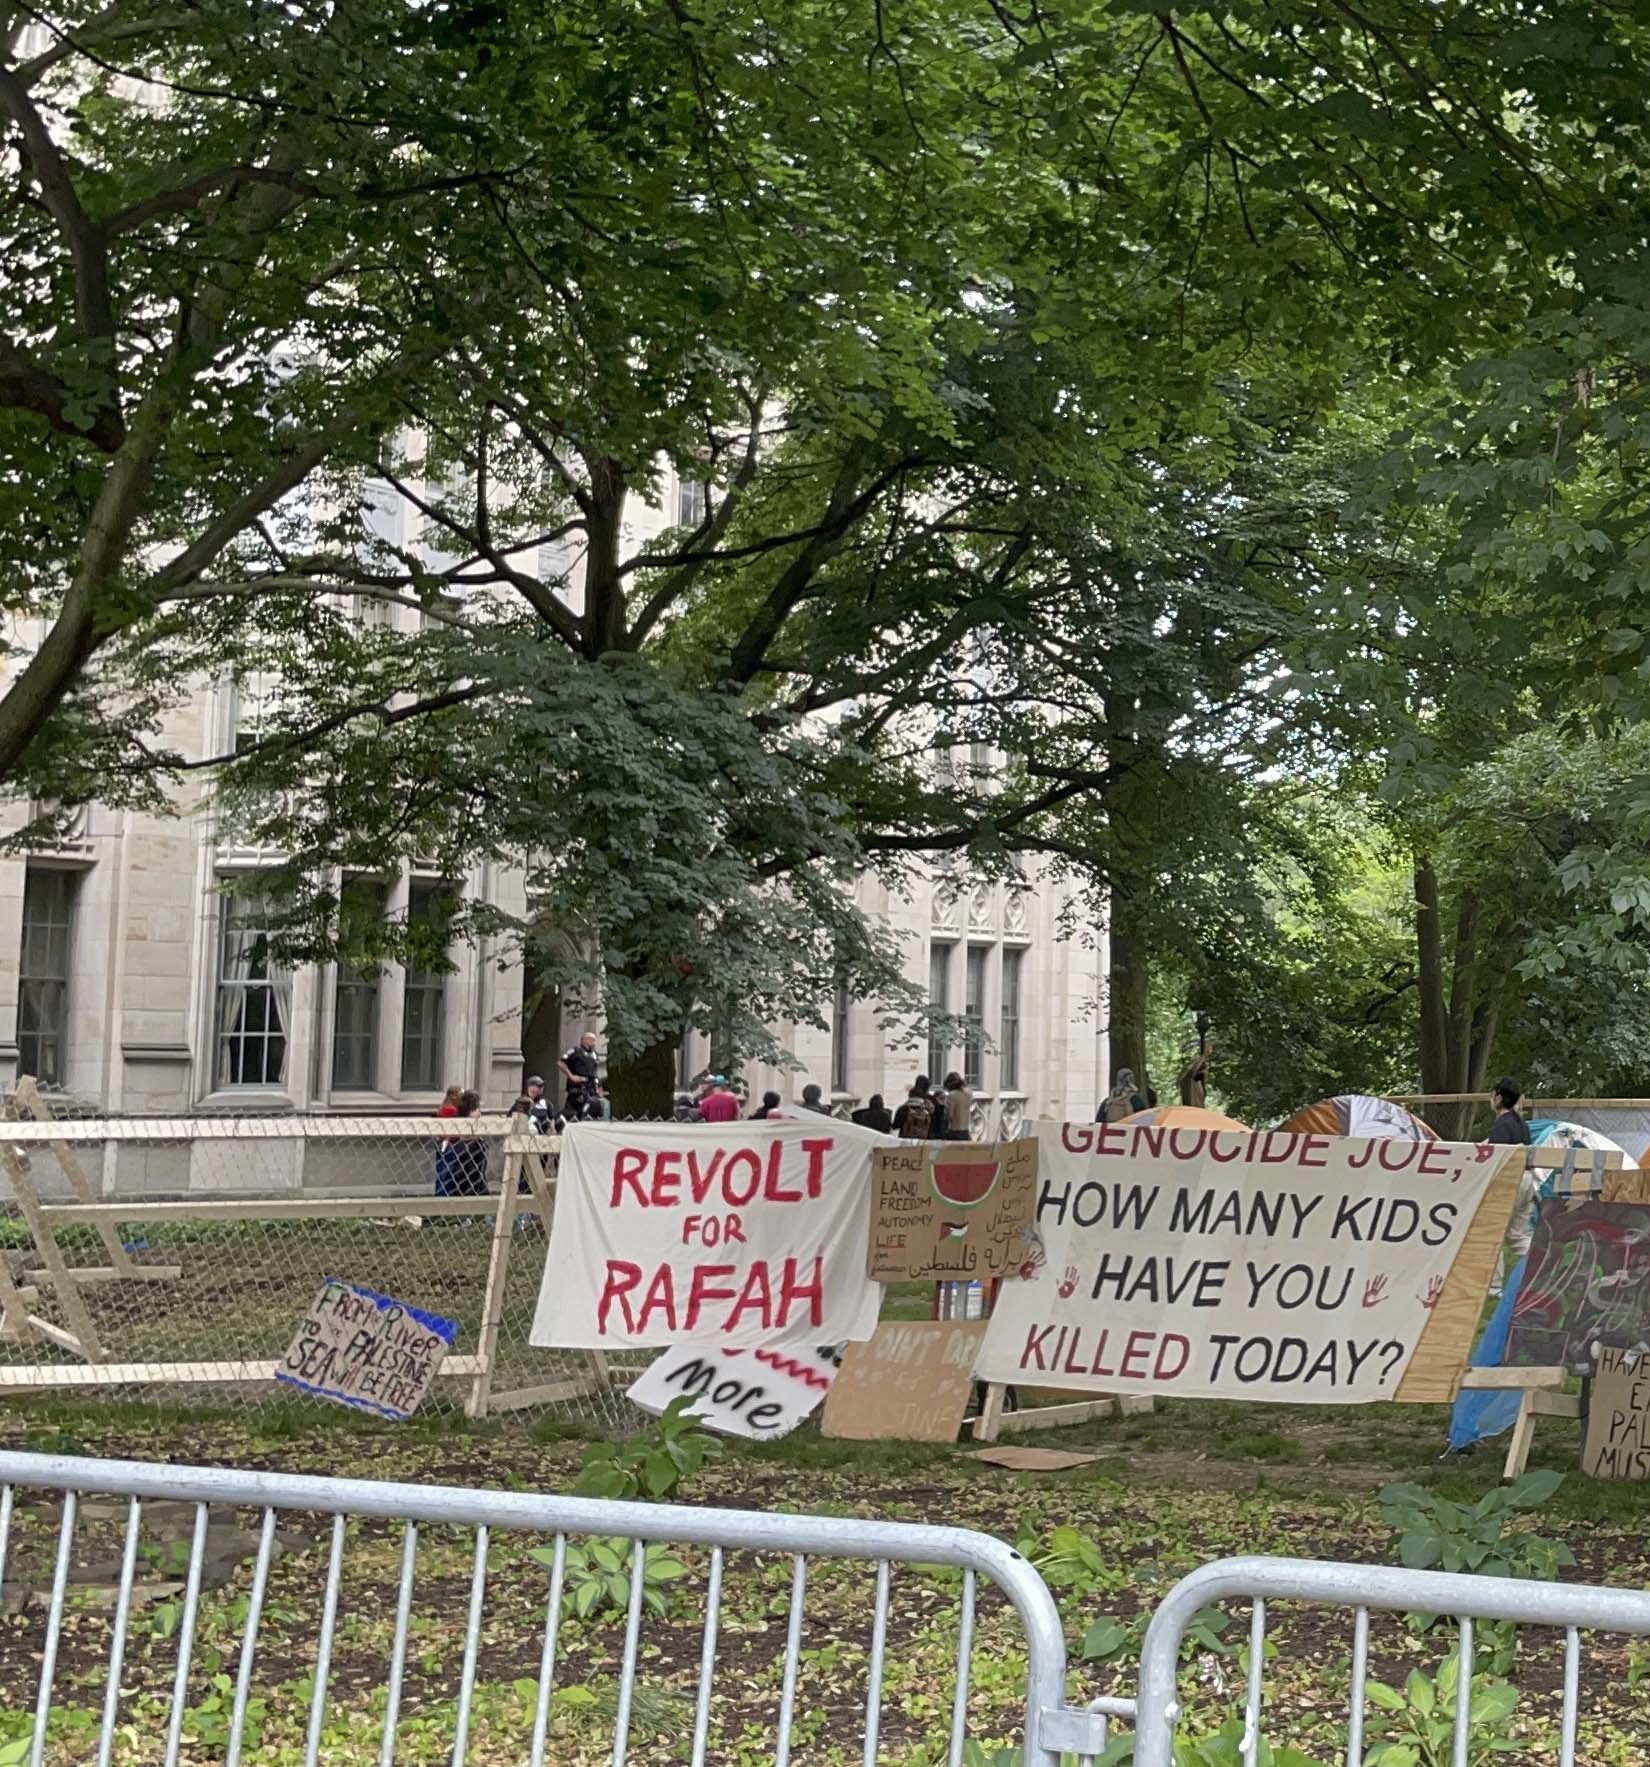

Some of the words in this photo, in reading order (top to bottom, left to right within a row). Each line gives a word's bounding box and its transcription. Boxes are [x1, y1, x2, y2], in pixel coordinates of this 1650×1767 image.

[610, 1138, 834, 1208] REVOLT
[1061, 1122, 1329, 1168] GENOCIDE
[1348, 1136, 1462, 1183] JOE,
[881, 1181, 918, 1195] LAND
[1036, 1180, 1160, 1230] HOW
[1168, 1187, 1323, 1239] MANY
[1330, 1195, 1458, 1246] KIDS
[682, 1213, 747, 1247] FOR
[876, 1235, 906, 1249] LIFE
[316, 1283, 374, 1328] FROM
[598, 1254, 823, 1335] RAFAH
[1091, 1253, 1230, 1307] HAVE
[1246, 1261, 1355, 1310] YOU
[287, 1338, 339, 1386] SEA
[380, 1373, 422, 1411] FREE
[302, 1319, 322, 1336] TO
[344, 1329, 432, 1385] PALESTINE
[1019, 1323, 1190, 1379] KILLED
[1209, 1335, 1405, 1385] TODAY?
[1602, 1350, 1650, 1380] HAVE
